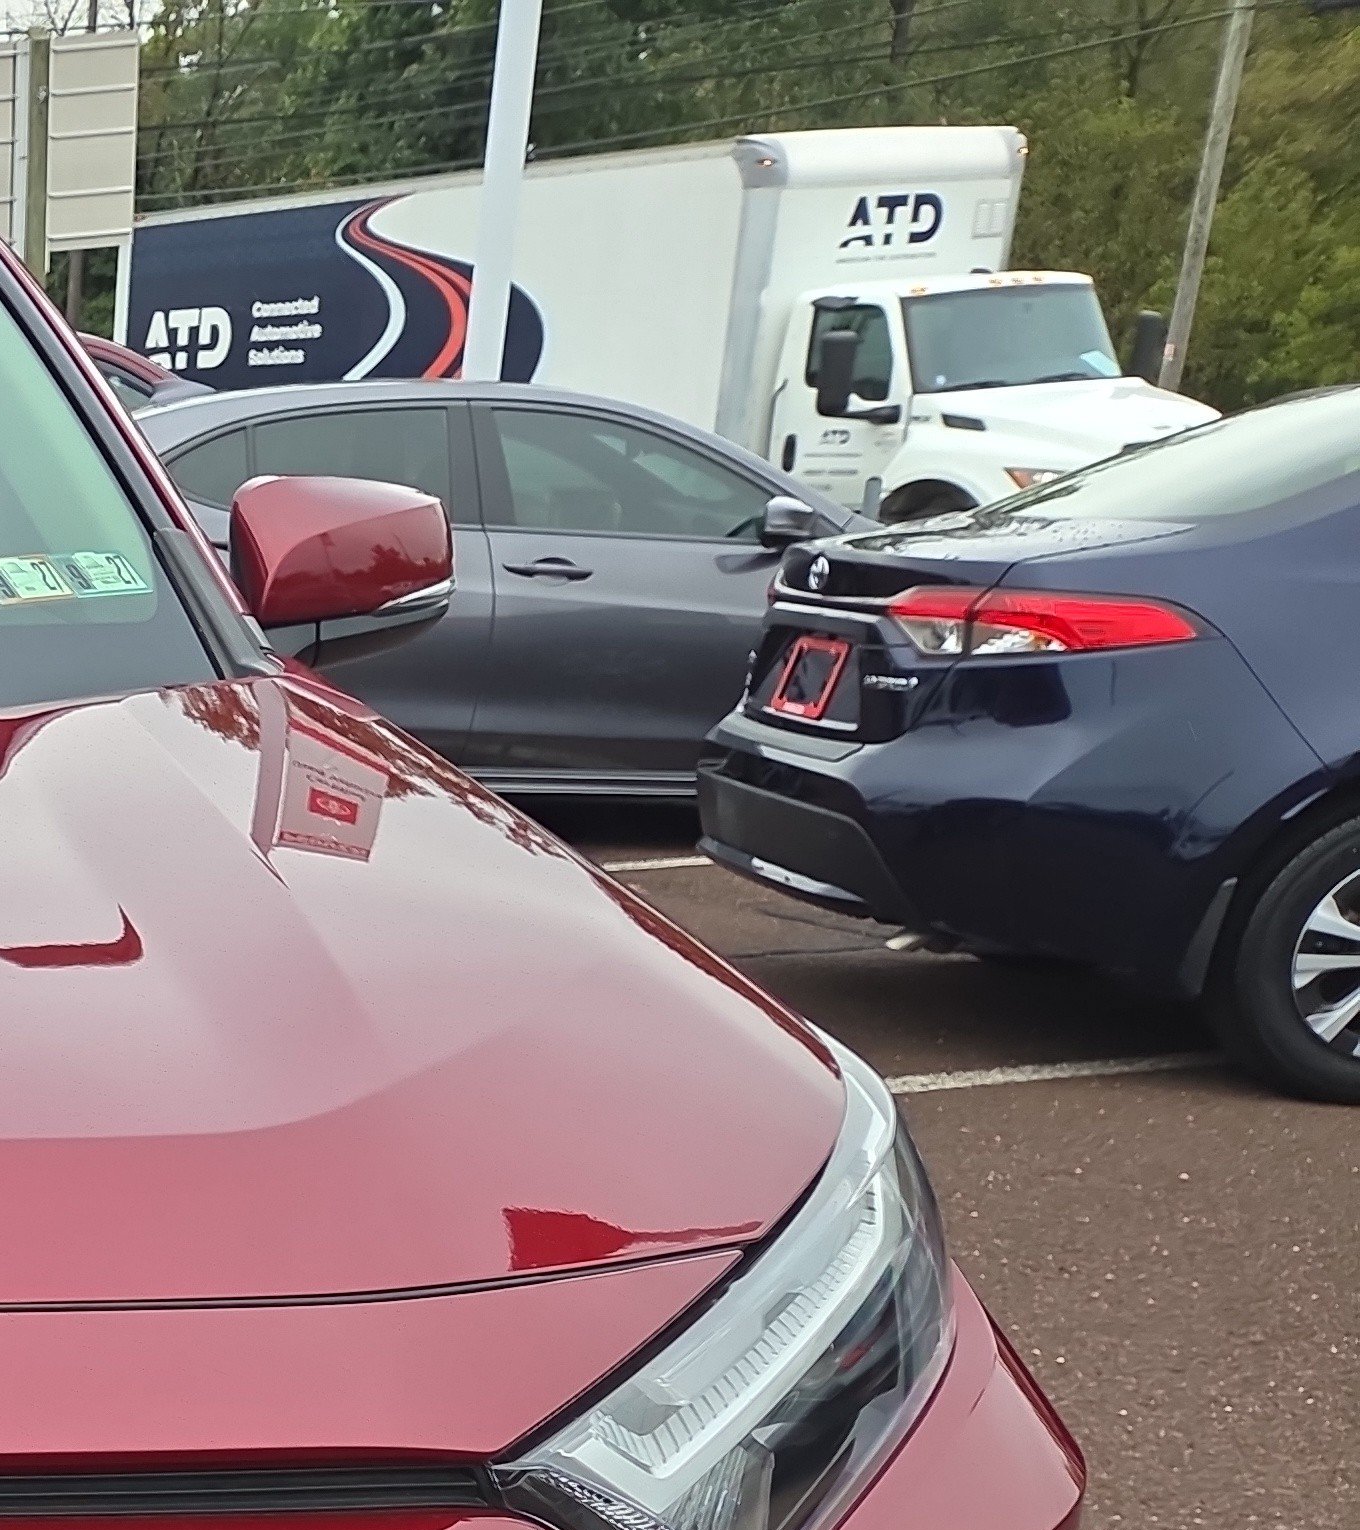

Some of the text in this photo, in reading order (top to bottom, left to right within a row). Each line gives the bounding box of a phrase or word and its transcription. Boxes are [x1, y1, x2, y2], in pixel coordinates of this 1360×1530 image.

[839, 193, 942, 248] ATD
[252, 295, 321, 318] Connected
[145, 306, 232, 370] ATD
[249, 320, 323, 342] Automotive
[248, 346, 305, 366] Solutions
